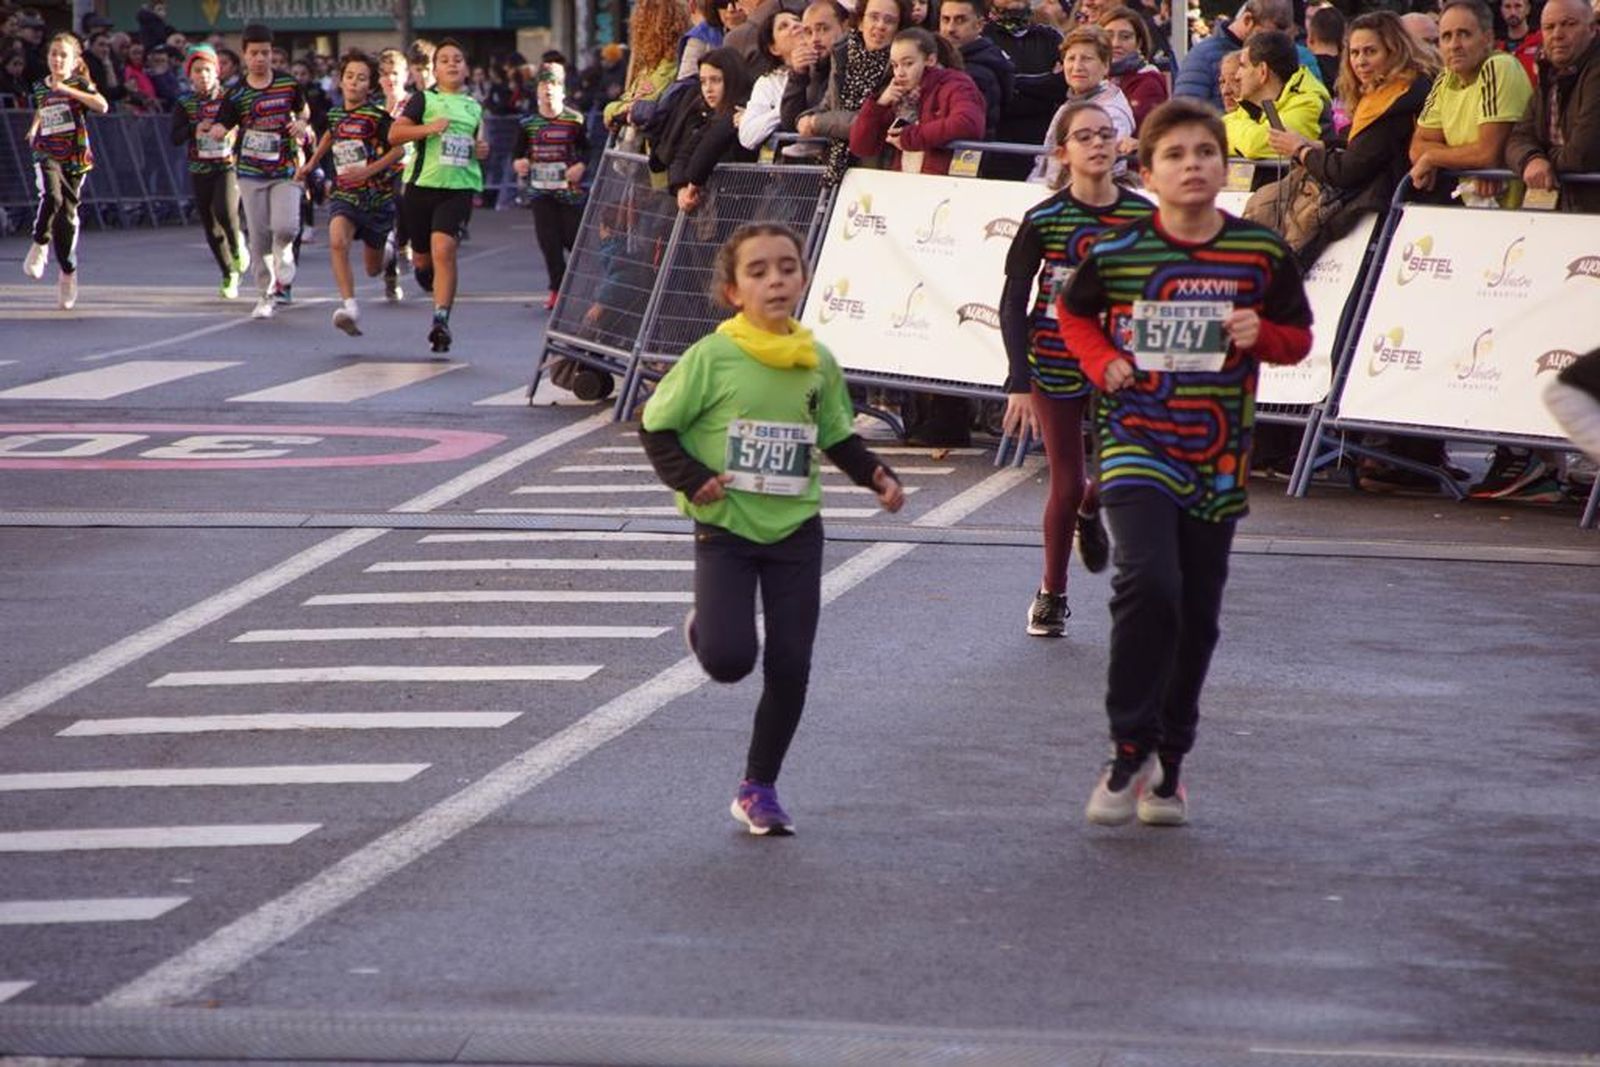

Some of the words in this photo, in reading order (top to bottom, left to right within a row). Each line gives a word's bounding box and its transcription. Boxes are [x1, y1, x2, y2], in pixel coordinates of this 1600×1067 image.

[333, 0, 426, 17] SALAMAA
[854, 214, 887, 230] SETEL
[1408, 257, 1453, 273] SETEL
[1176, 278, 1238, 296] XXXVIII
[829, 298, 866, 315] SETEL
[1159, 305, 1223, 318] SETEL
[1146, 319, 1209, 349] 5747
[1379, 349, 1423, 365] SETEL
[754, 425, 809, 440] SETEL
[739, 439, 798, 471] 5797
